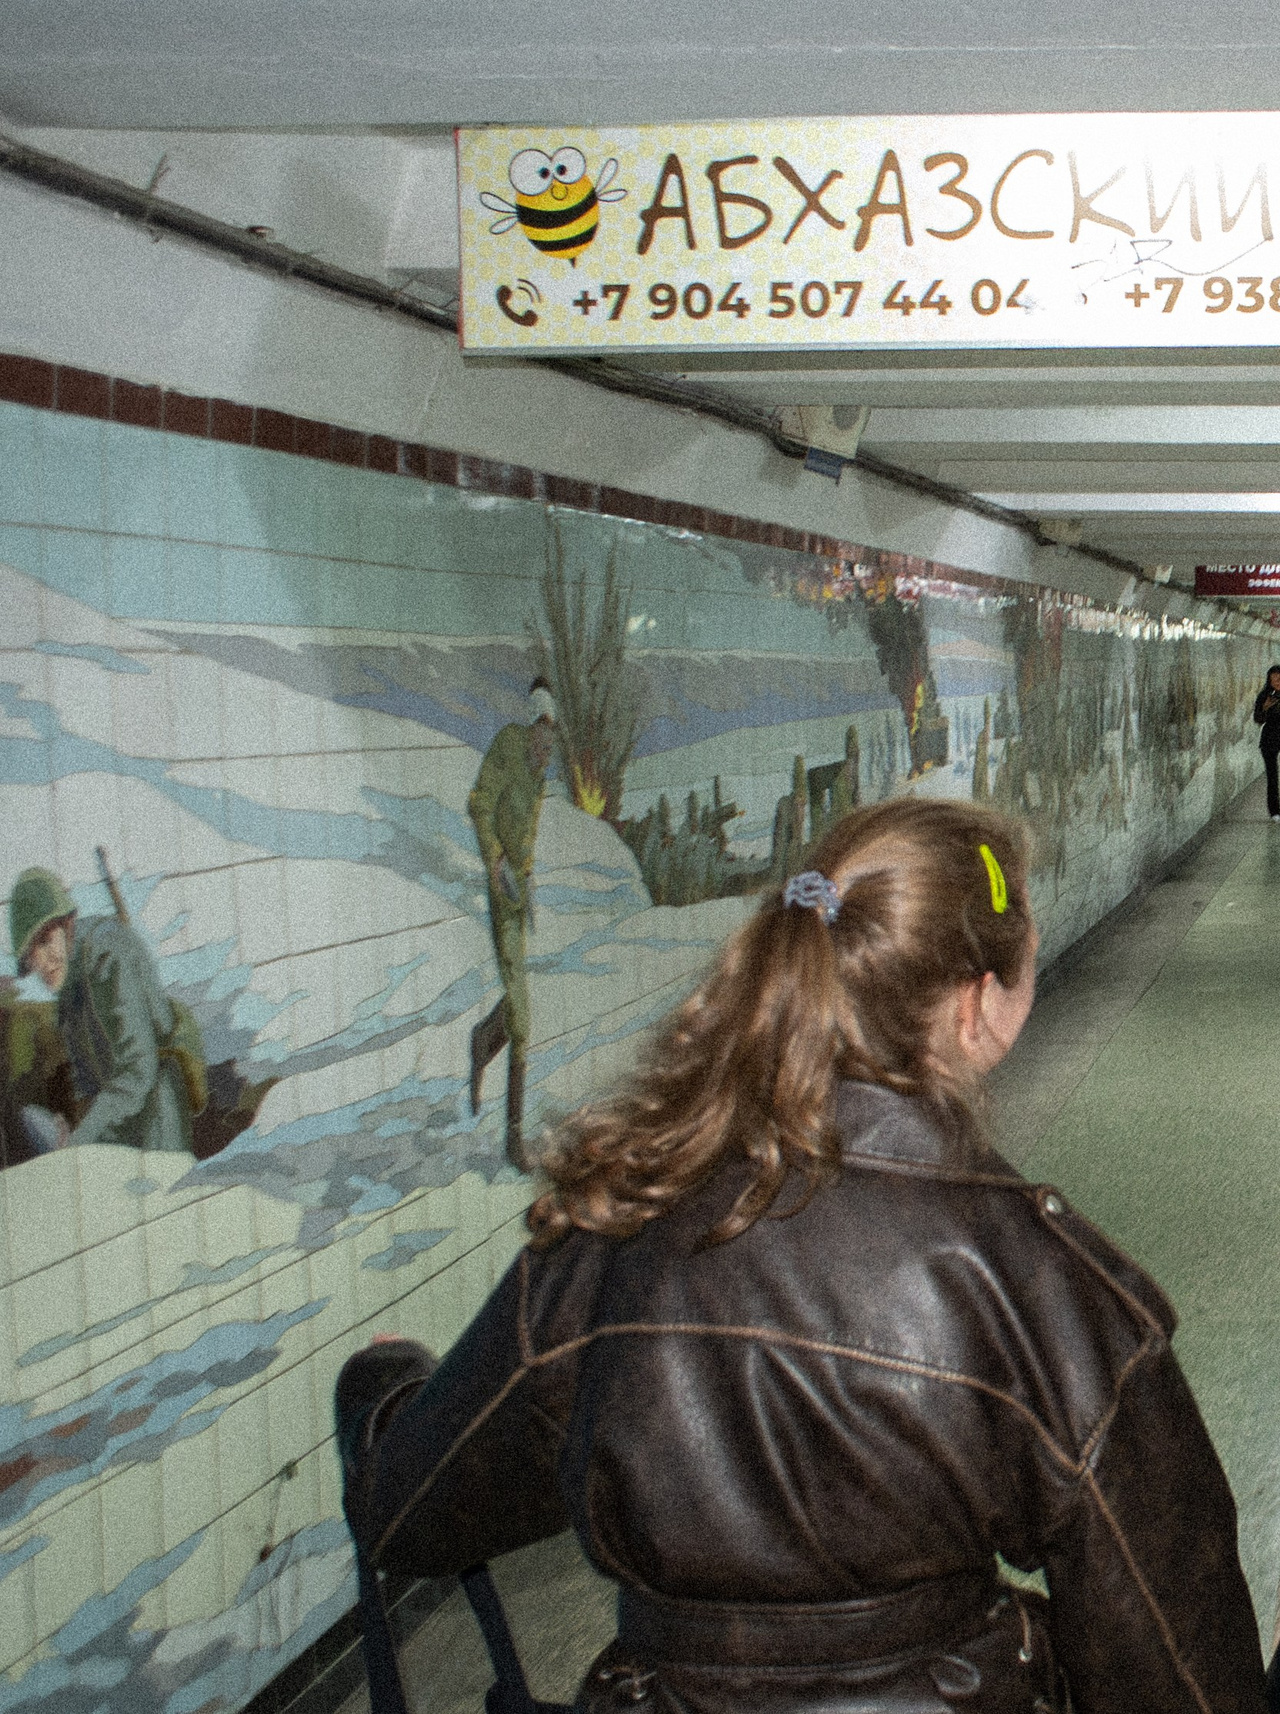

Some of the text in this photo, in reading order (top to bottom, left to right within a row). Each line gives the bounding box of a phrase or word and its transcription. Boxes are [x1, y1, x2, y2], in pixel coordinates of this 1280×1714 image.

[573, 282, 632, 322] +7
[646, 282, 751, 320] 904
[768, 281, 864, 319] 507
[882, 280, 953, 317] 44
[1124, 276, 1184, 315] +7
